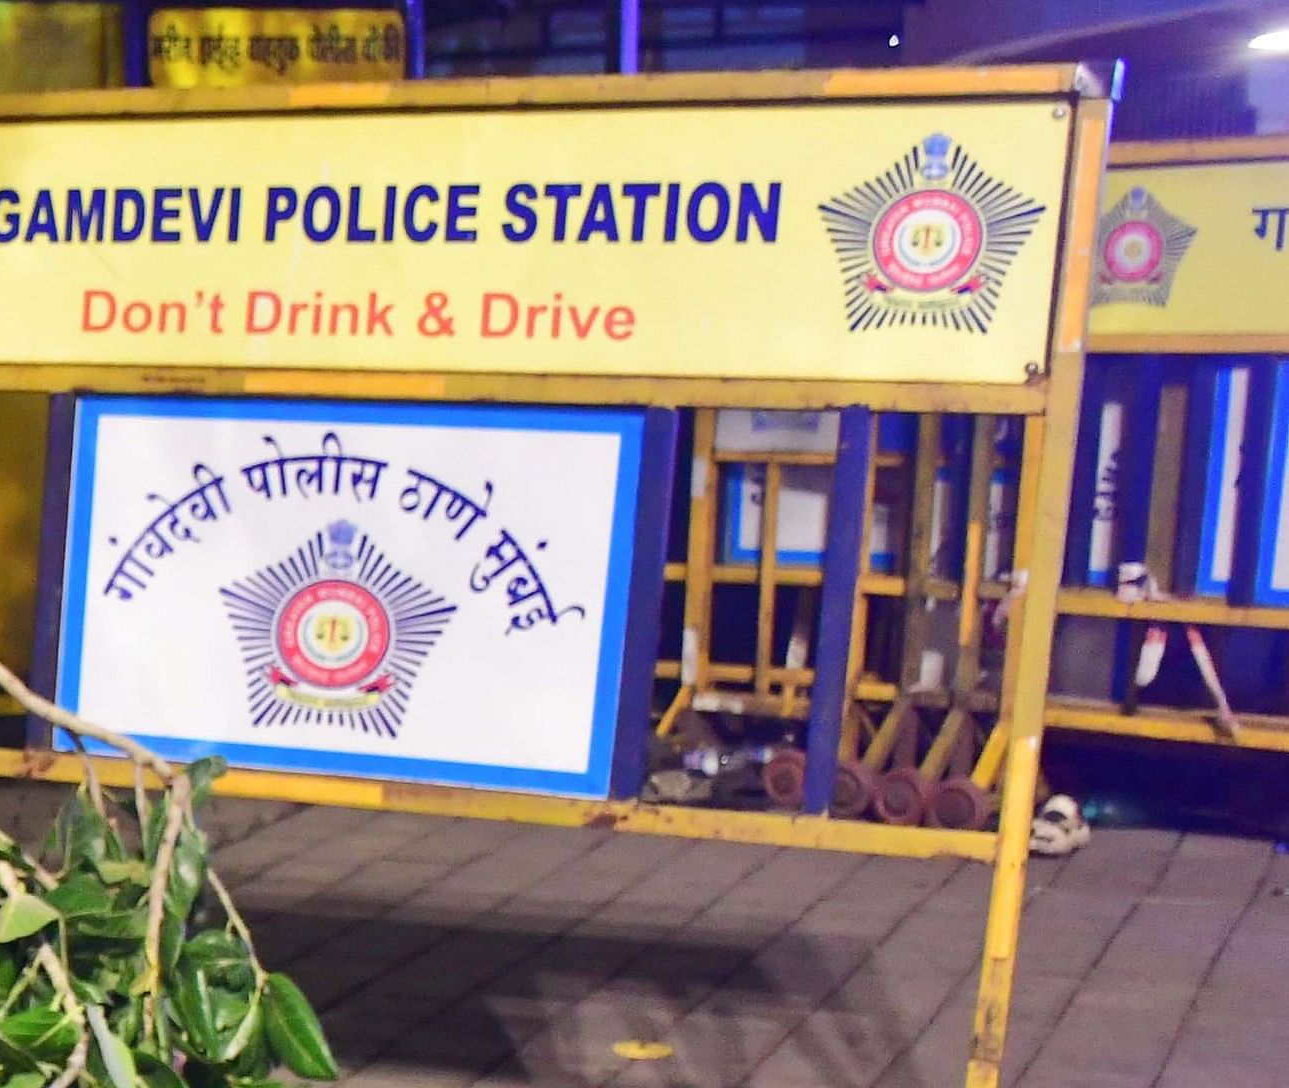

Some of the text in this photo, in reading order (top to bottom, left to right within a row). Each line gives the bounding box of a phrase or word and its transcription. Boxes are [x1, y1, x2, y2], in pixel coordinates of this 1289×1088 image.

[264, 183, 481, 243] POLICE
[502, 181, 783, 243] STATION
[81, 288, 637, 341] Don't Drink & Drive
[103, 462, 232, 601] गांवदेवी
[241, 431, 389, 503] पोलीस
[399, 468, 494, 541] ठाणे
[469, 527, 586, 637] मुंबई
